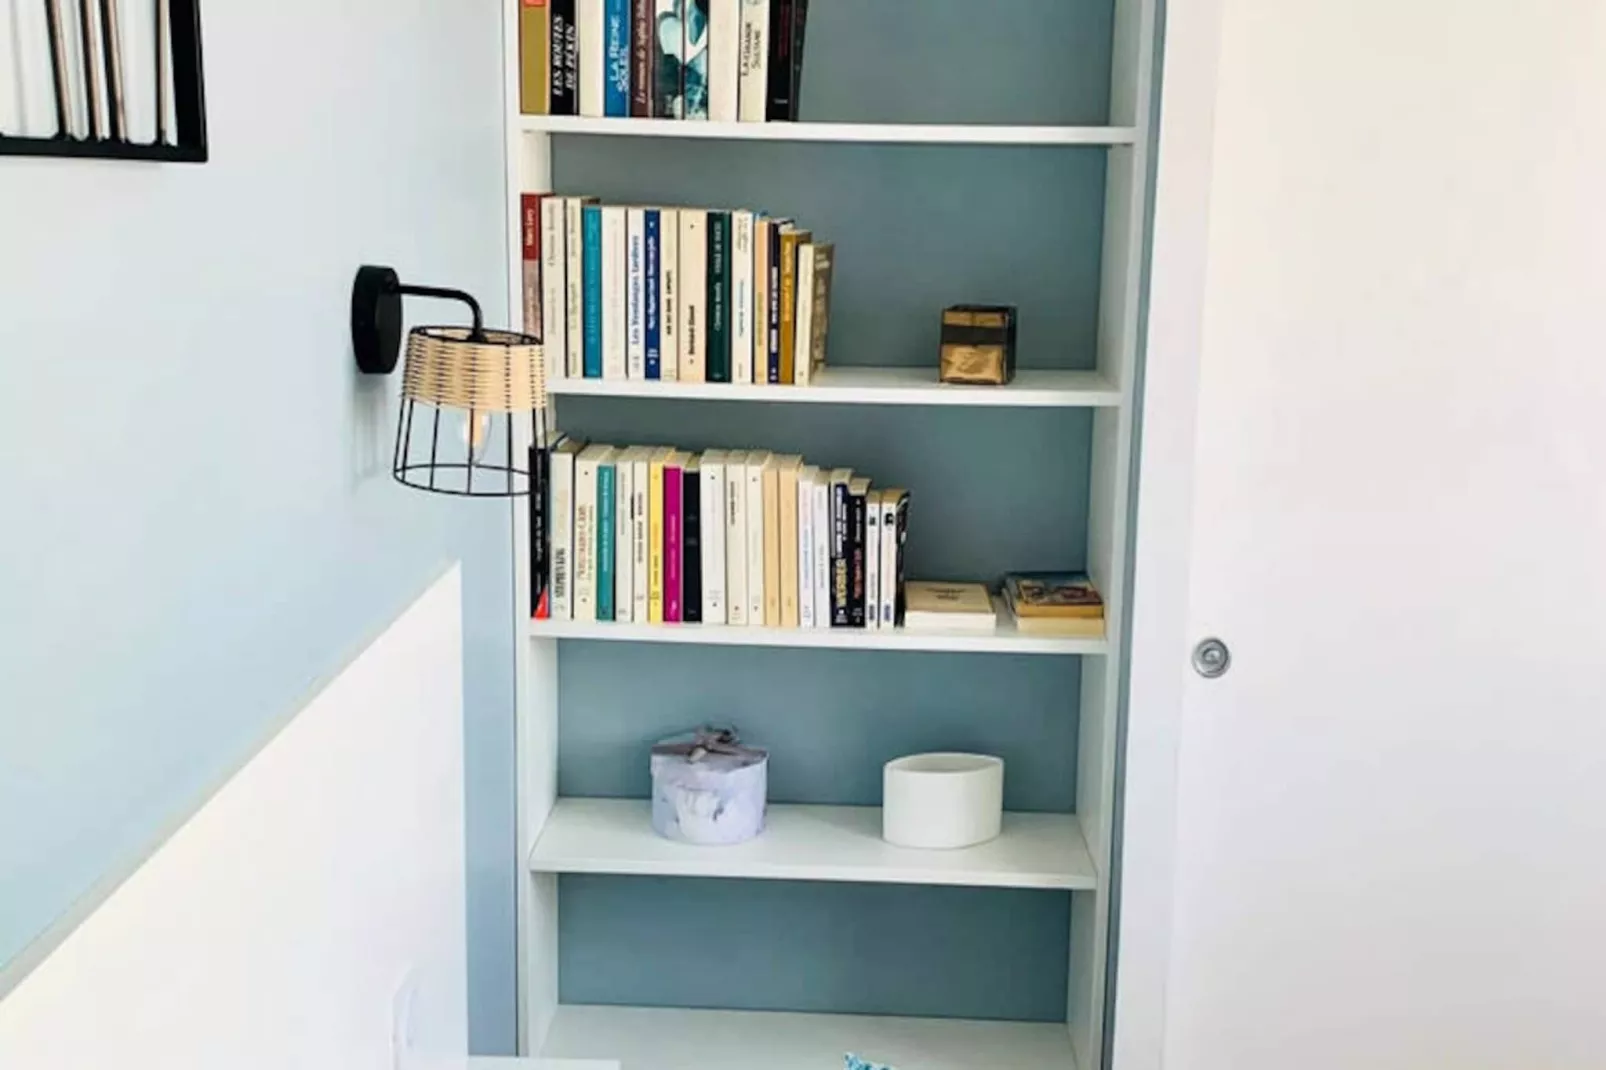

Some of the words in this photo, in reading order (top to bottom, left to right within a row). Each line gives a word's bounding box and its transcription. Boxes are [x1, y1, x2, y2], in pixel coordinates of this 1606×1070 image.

[552, 12, 564, 68] ROUTES
[608, 15, 620, 59] REINE
[565, 67, 576, 91] DE
[609, 61, 619, 81] LA
[616, 45, 628, 93] SOLEIL
[552, 69, 564, 97] LES
[635, 92, 646, 104] Le
[524, 208, 535, 227] Levy
[524, 228, 534, 246] Marc
[631, 276, 642, 326] Vendanges
[631, 328, 640, 345] Les
